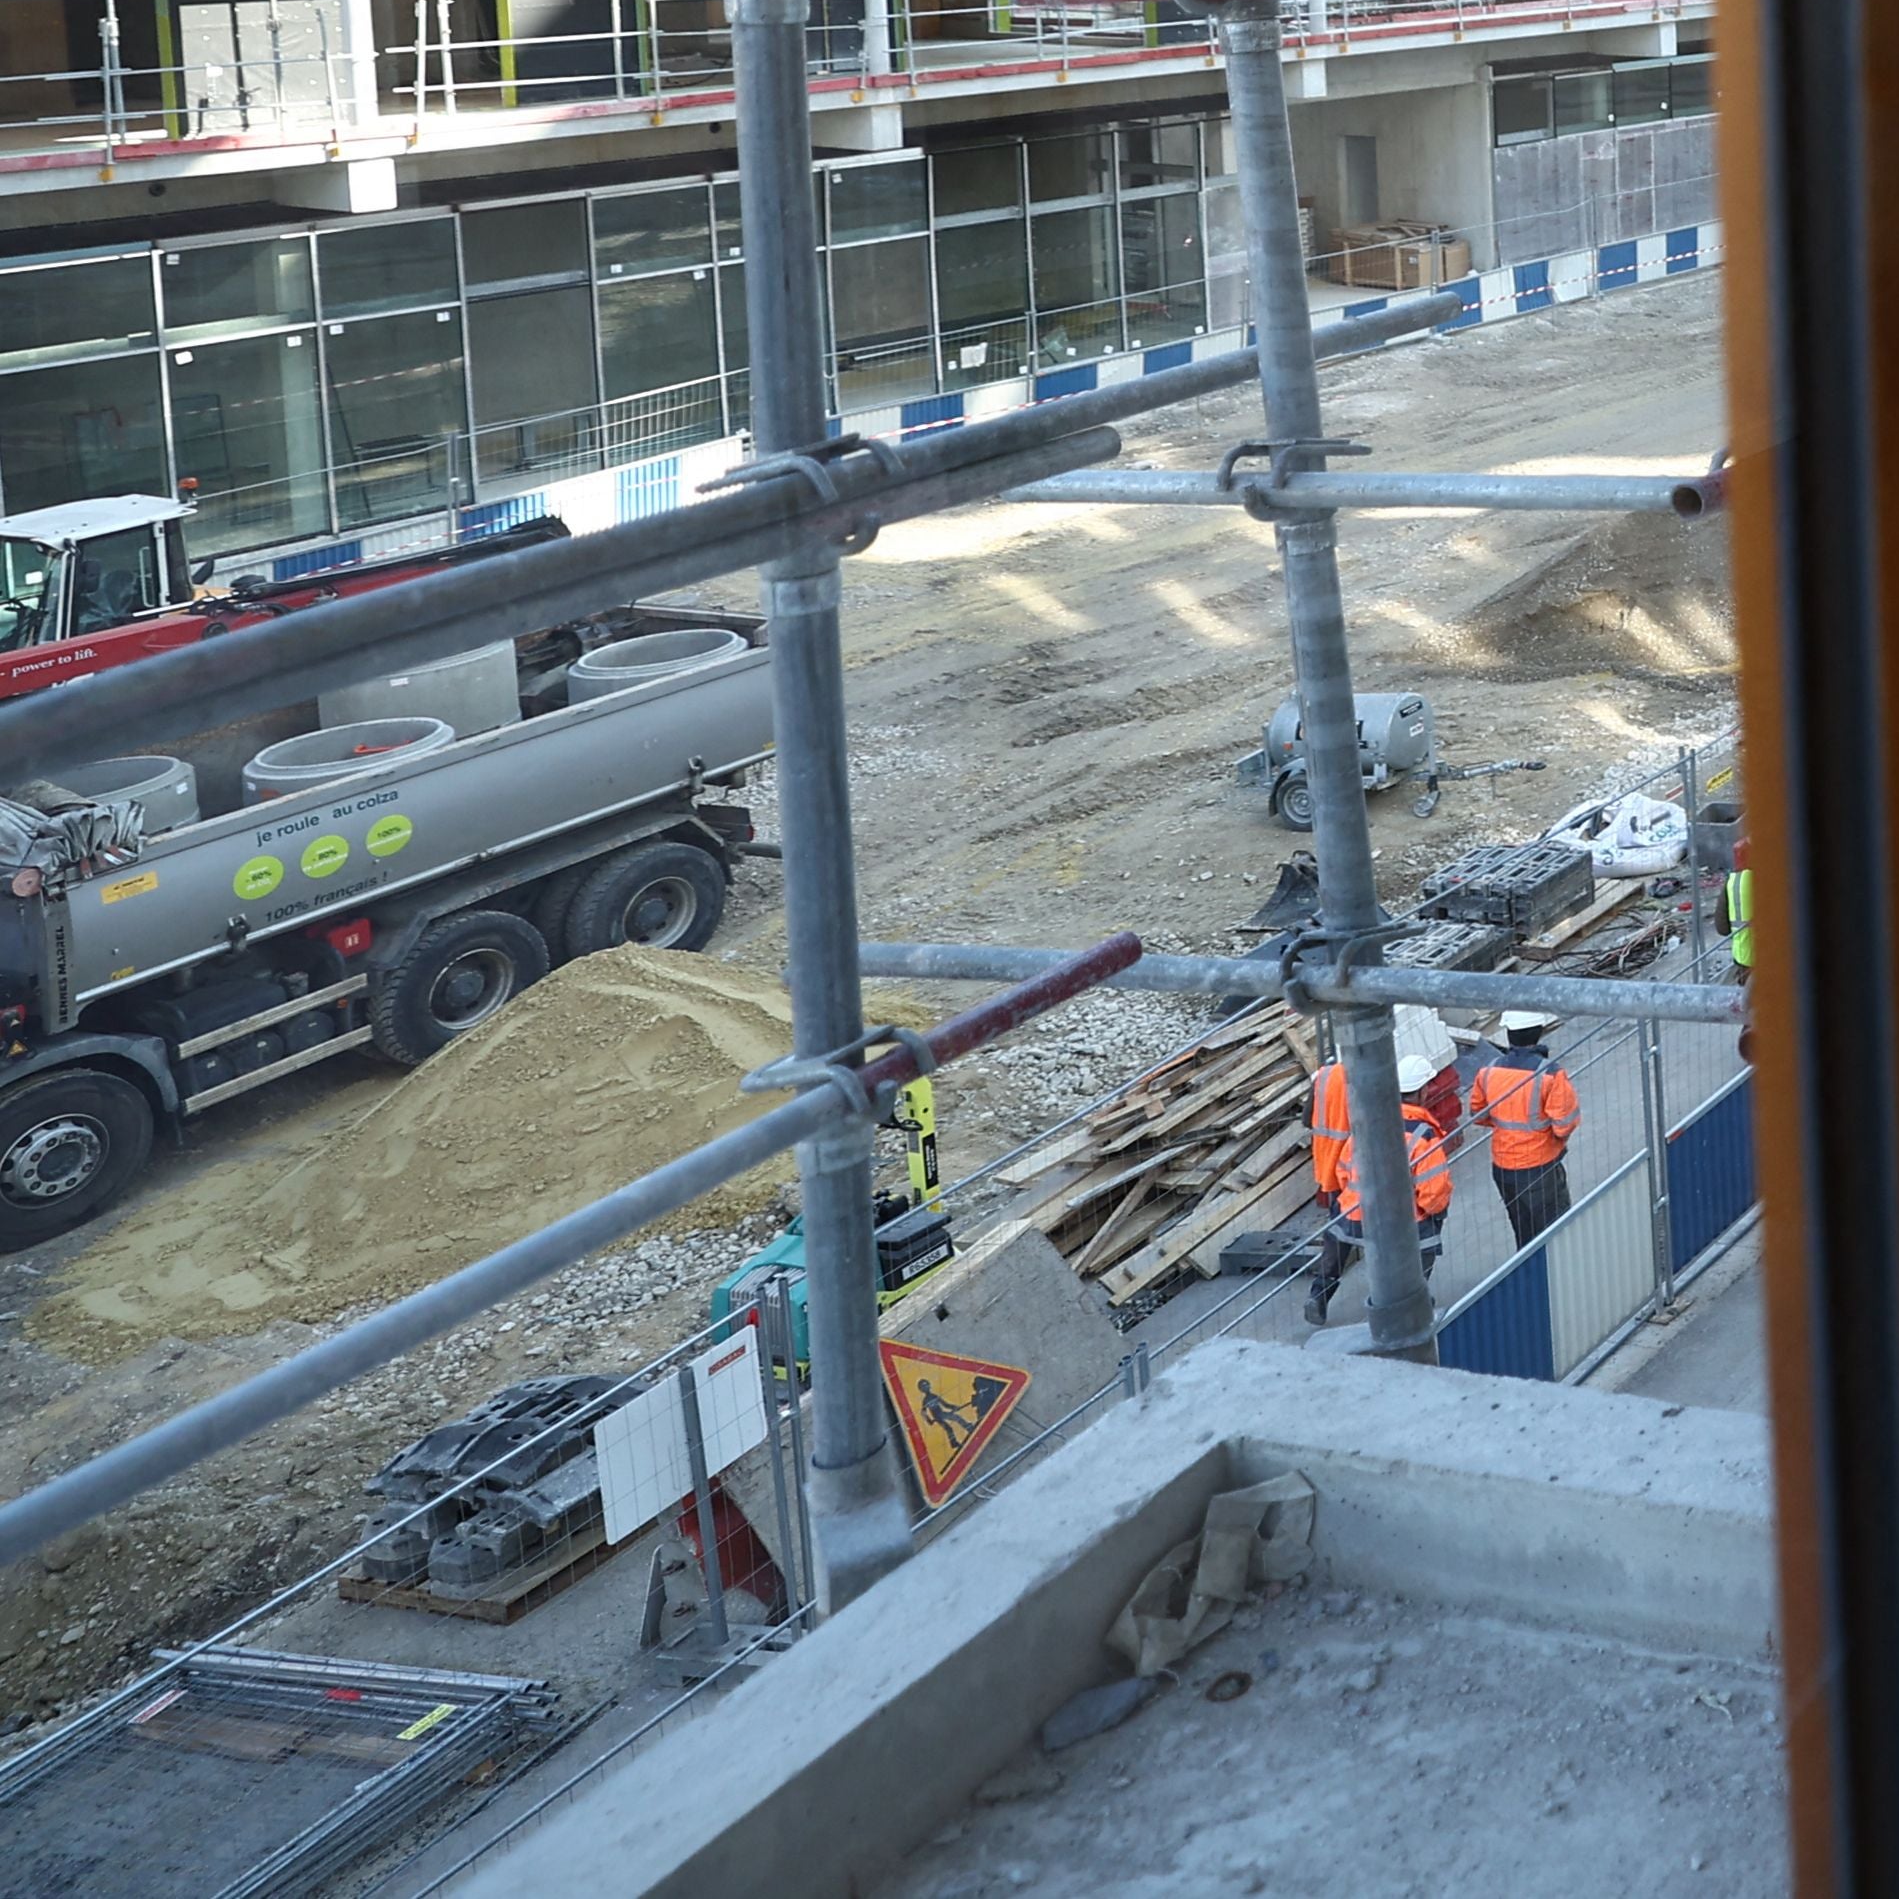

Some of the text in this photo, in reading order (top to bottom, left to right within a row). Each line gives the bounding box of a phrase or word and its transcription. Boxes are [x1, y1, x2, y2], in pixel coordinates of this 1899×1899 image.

[12, 659, 55, 677] power
[58, 654, 72, 665] to
[74, 648, 98, 662] lift.
[256, 790, 399, 847] je roule au colza
[266, 902, 309, 922] 100%
[314, 875, 377, 906] français
[56, 925, 68, 1025] BENNES MARREL
